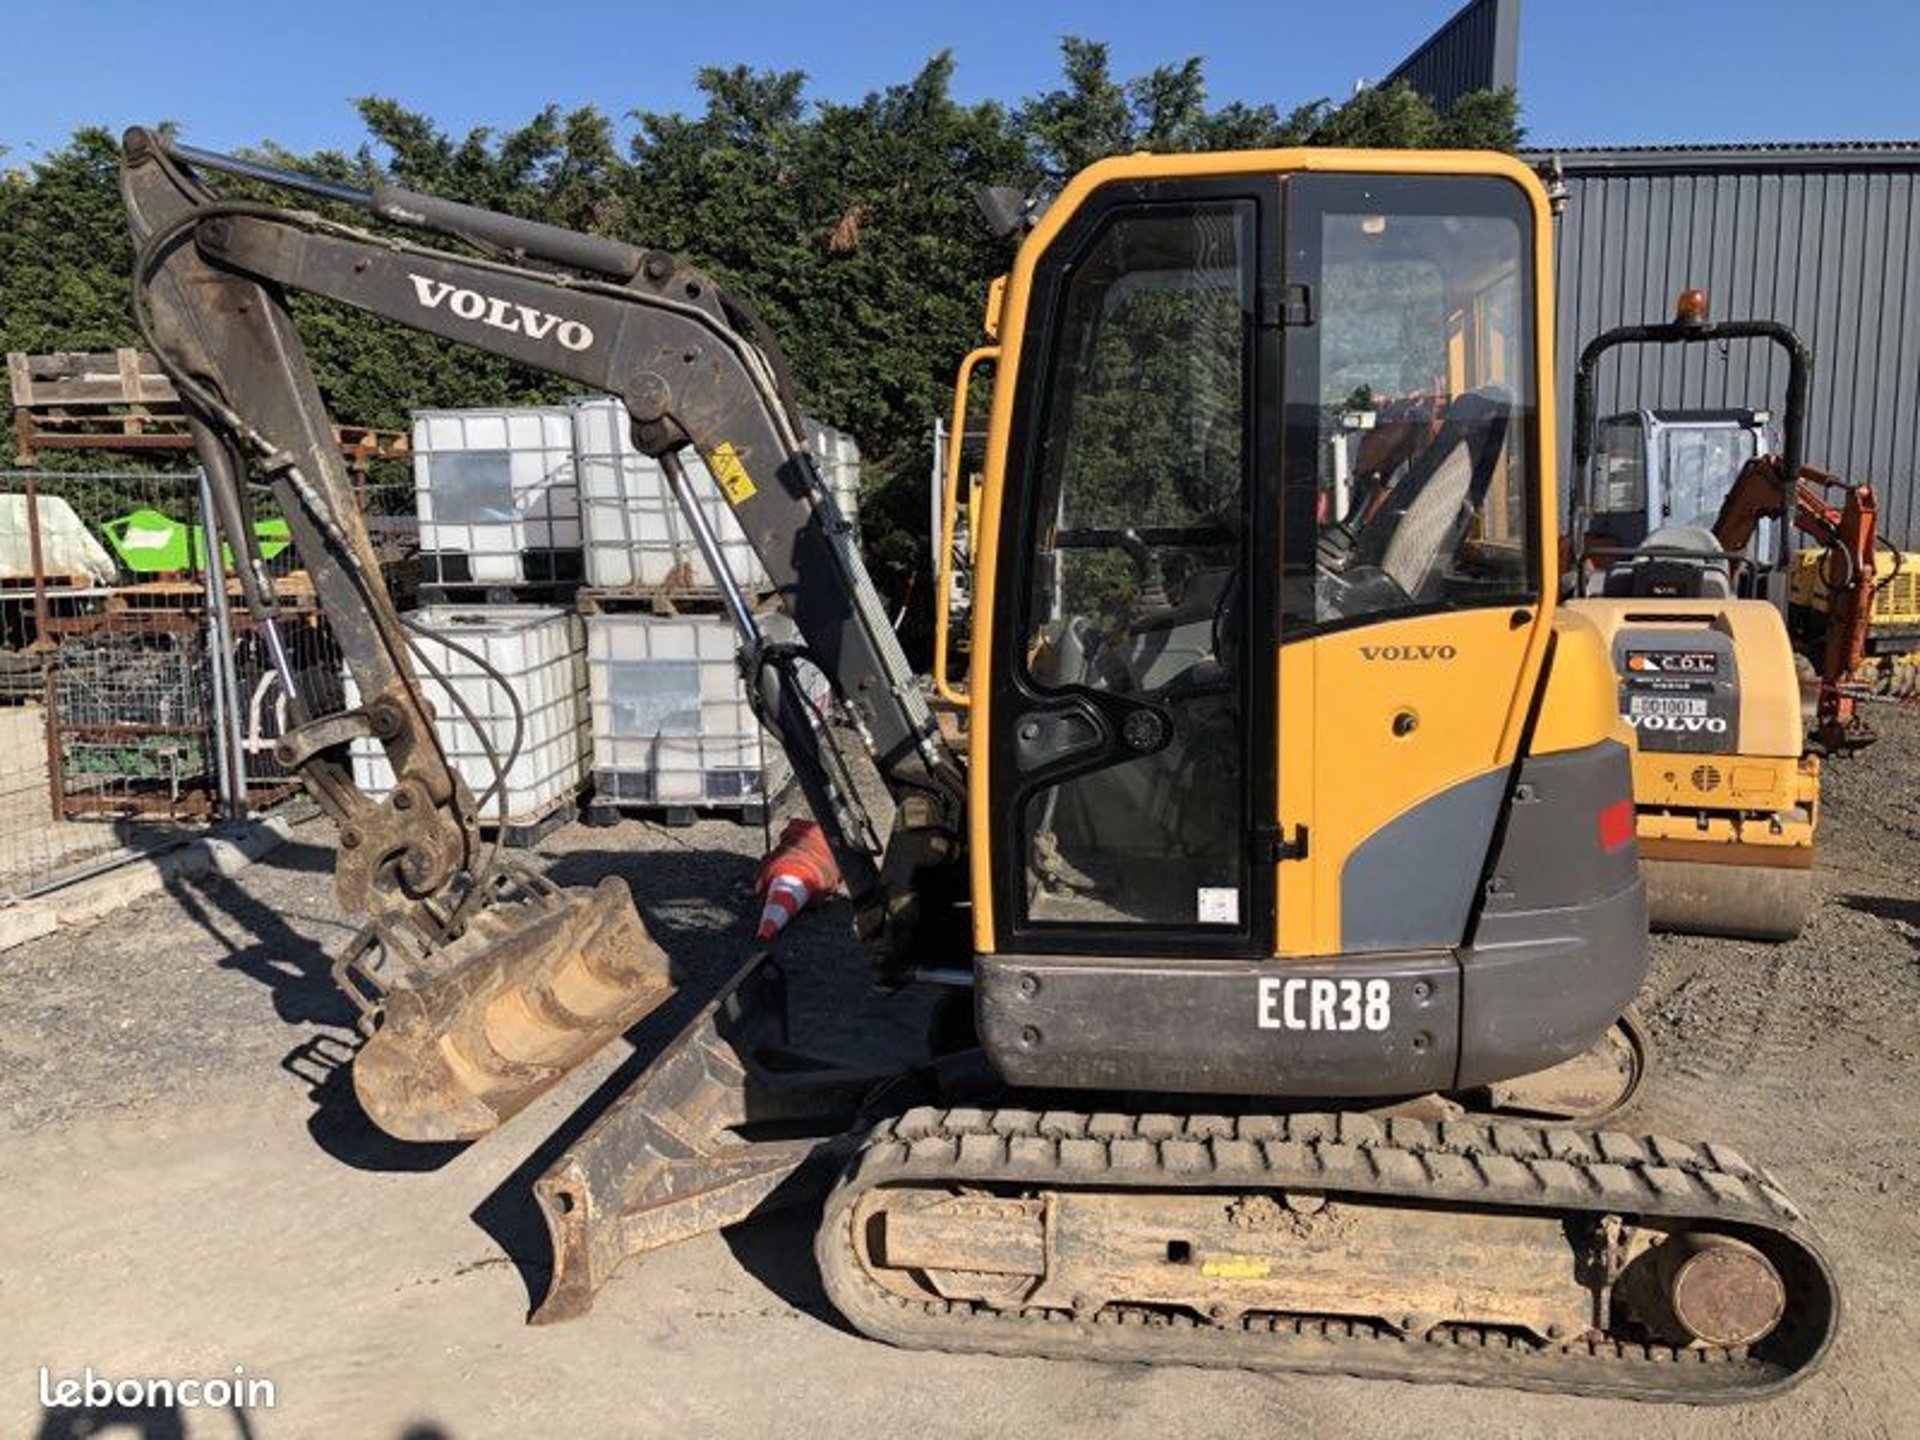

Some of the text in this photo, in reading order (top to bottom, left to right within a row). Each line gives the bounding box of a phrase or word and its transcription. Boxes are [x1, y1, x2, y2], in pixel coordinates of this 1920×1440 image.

[407, 273, 594, 350] VOLVO
[1359, 645, 1457, 660] VOLVO
[1619, 714, 1727, 733] VOLVO
[1258, 977, 1391, 1031] ECR38
